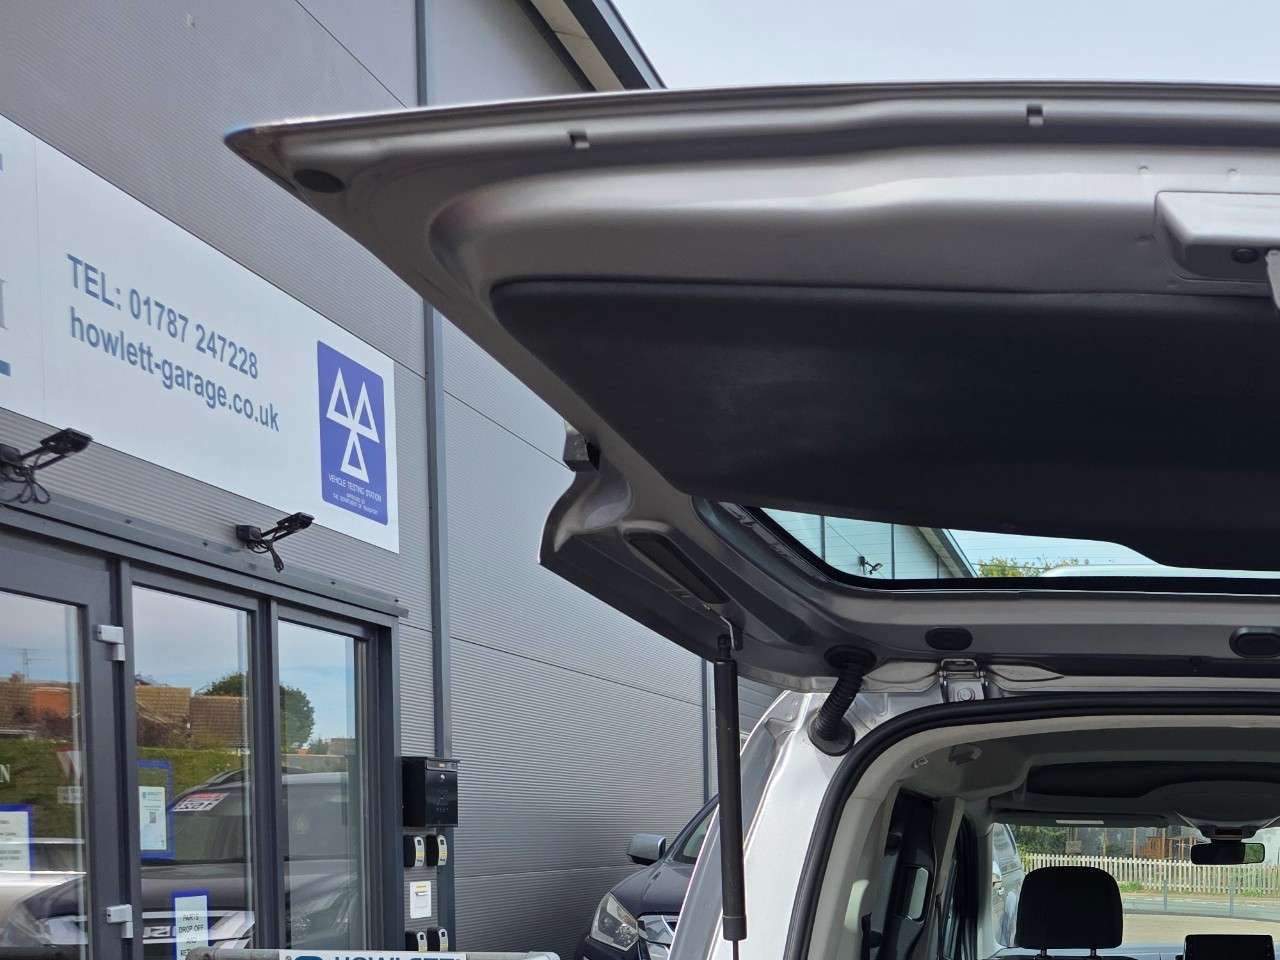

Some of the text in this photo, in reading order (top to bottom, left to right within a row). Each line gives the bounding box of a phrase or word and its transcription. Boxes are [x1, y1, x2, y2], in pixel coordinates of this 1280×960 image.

[67, 254, 121, 310] TEL:
[129, 288, 189, 343] 01787
[195, 324, 259, 380] 247228
[70, 306, 280, 432] howlett-garage.co.uk
